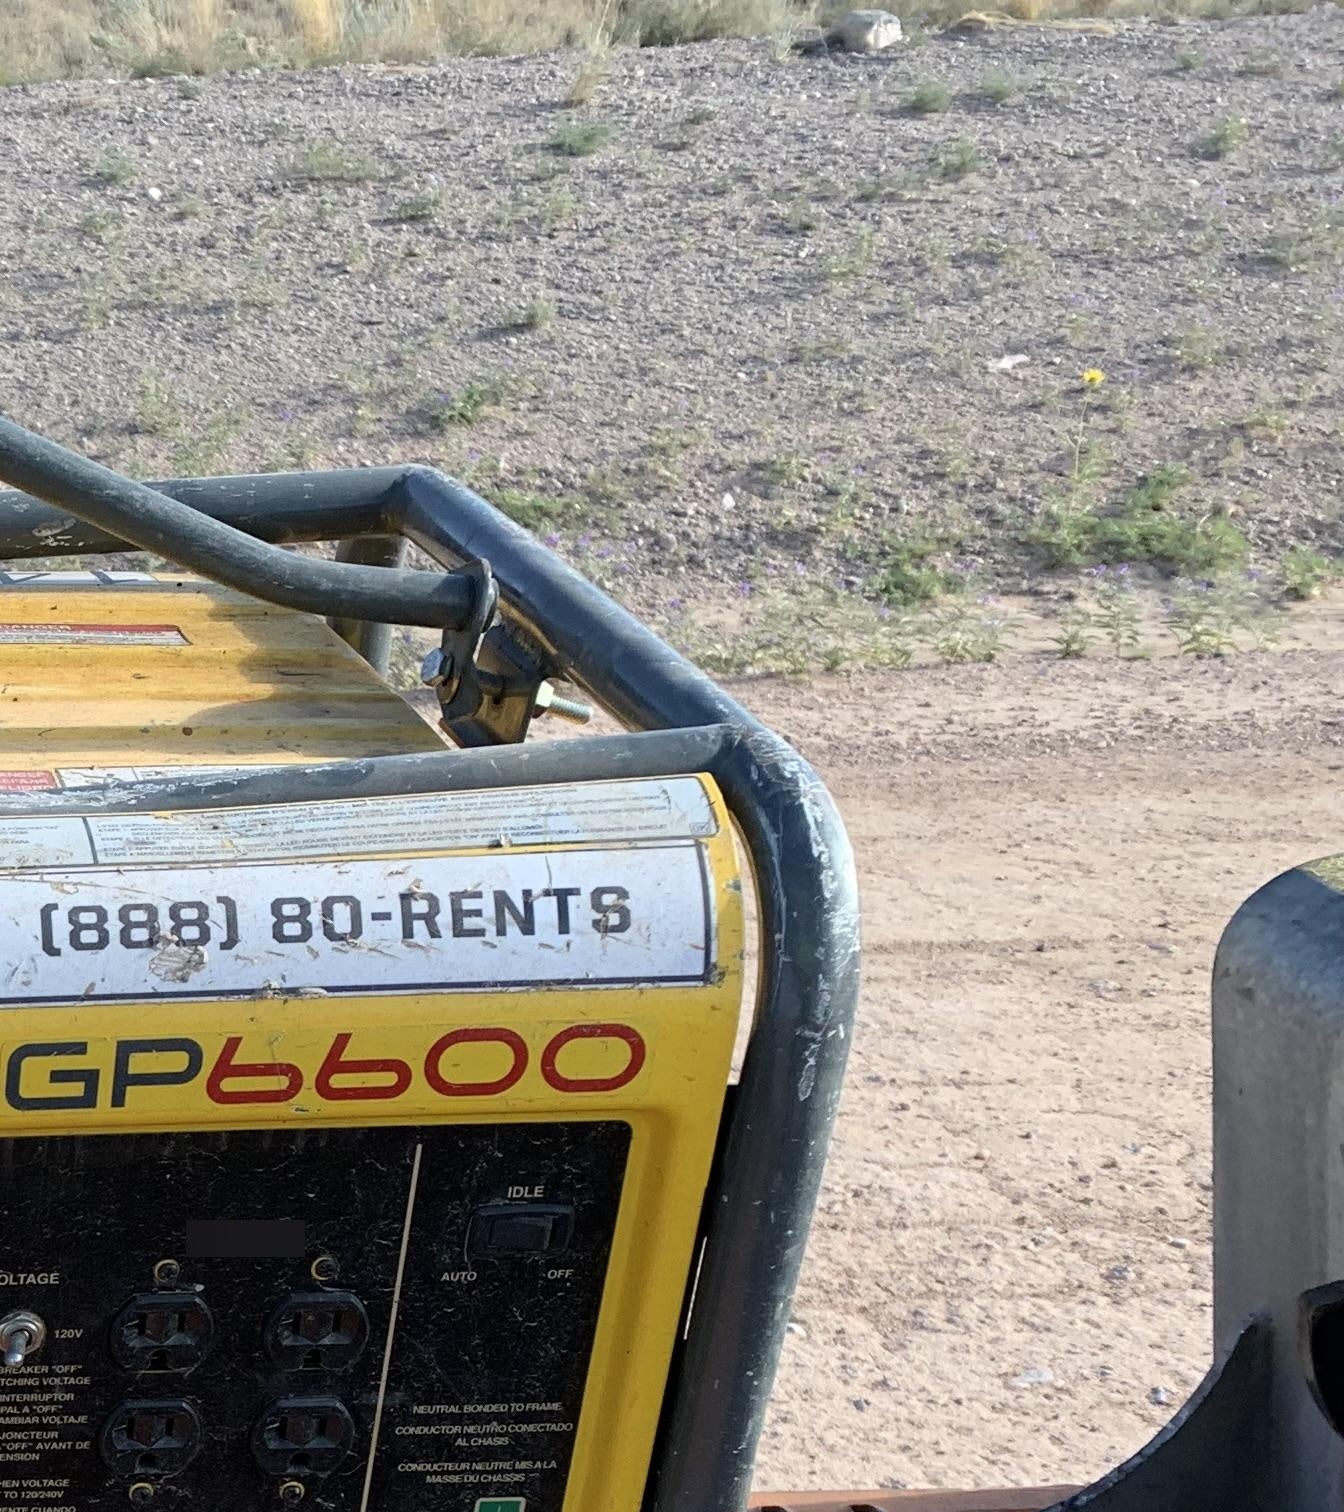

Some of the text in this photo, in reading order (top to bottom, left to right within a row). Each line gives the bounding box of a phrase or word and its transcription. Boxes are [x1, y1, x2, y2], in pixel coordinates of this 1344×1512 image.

[40, 886, 632, 957] (888) 80-RENTS
[4, 1023, 647, 1111] GP6600
[507, 1185, 544, 1198] IDLE
[441, 1272, 477, 1281] AUTO
[547, 1269, 574, 1279] OFF
[54, 1329, 83, 1338] 120V
[42, 1377, 91, 1385] VOLTAGE
[0, 1393, 74, 1402] INTERRUPTOR
[413, 1402, 562, 1414] NEUTRAL BONDED TO FRAME
[42, 1416, 88, 1424] VOLTAJE
[395, 1423, 573, 1435] CONDUCTOR NEUTRO CONECTADO
[36, 1442, 73, 1450] AVANT
[75, 1441, 90, 1449] DE
[455, 1437, 509, 1446] AL CHASIS
[398, 1463, 470, 1472] CONDUCTEUR
[426, 1473, 525, 1483] MASSE DU CHASSIS
[22, 1479, 70, 1487] VOLTAGE
[5, 1491, 18, 1499] TO
[21, 1491, 64, 1499] 120/240V
